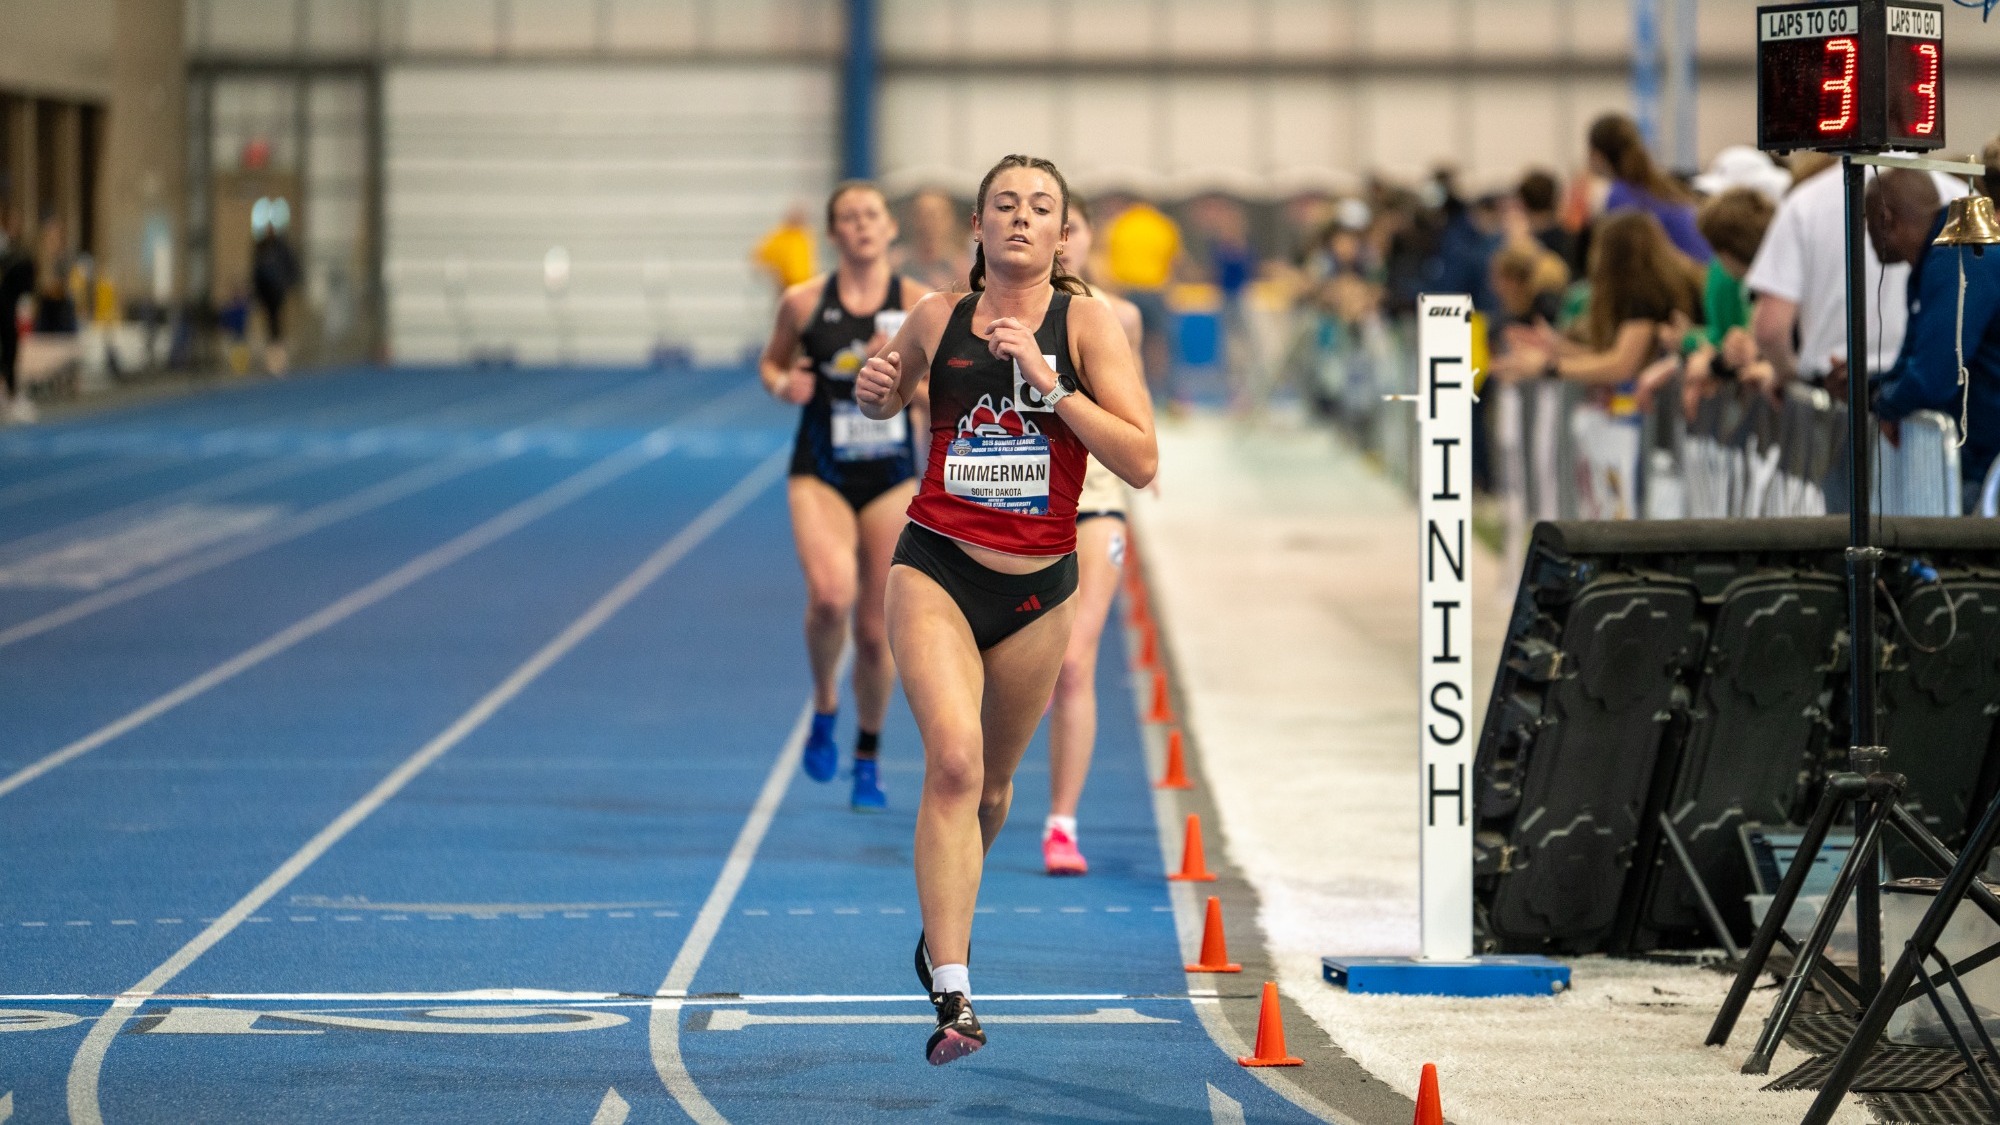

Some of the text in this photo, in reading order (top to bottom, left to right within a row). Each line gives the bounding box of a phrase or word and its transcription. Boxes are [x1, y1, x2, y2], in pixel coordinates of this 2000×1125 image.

[1770, 9, 1847, 37] LAPS TO GO
[1891, 9, 1935, 36] LAPS TO GO
[1819, 39, 1855, 131] 3
[1916, 44, 1938, 134] 3
[1429, 306, 1462, 317] GILL
[948, 464, 1046, 482] TIMMERMAN
[971, 488, 1022, 496] SOUTH DAKOTA
[1428, 356, 1465, 828] FINISH
